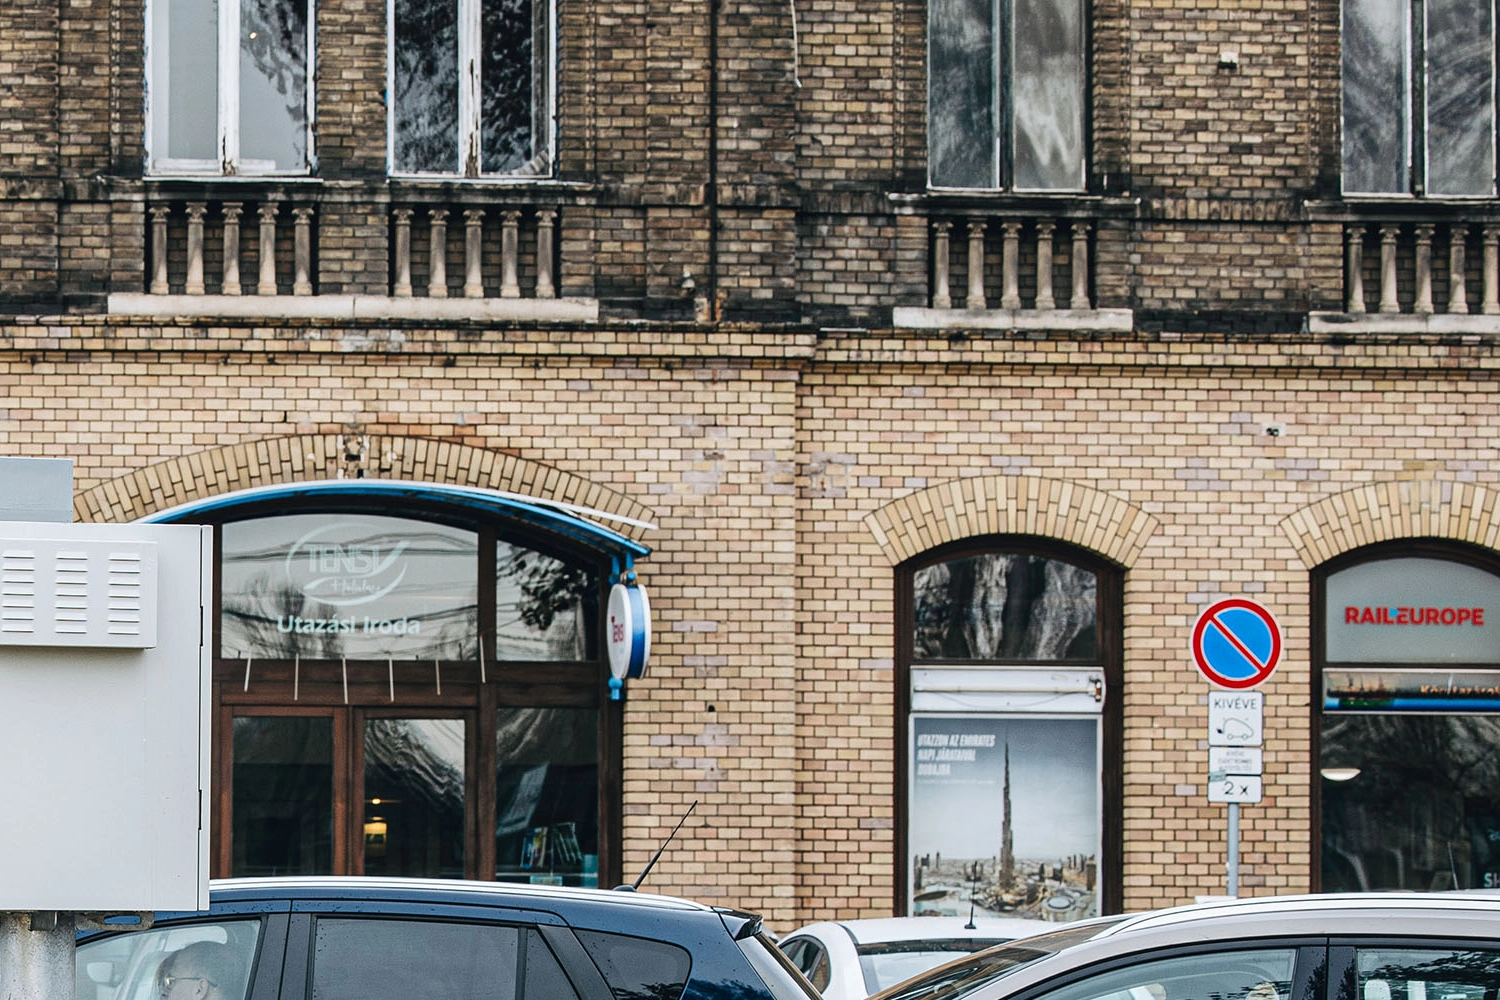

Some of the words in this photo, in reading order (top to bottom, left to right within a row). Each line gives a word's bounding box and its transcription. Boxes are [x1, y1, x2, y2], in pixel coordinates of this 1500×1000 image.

[277, 613, 356, 633] Utazási
[363, 615, 421, 634] Iroda
[1345, 606, 1485, 626] RAILEUROPE
[1214, 697, 1257, 709] KIVÉVE
[1224, 780, 1235, 796] 2
